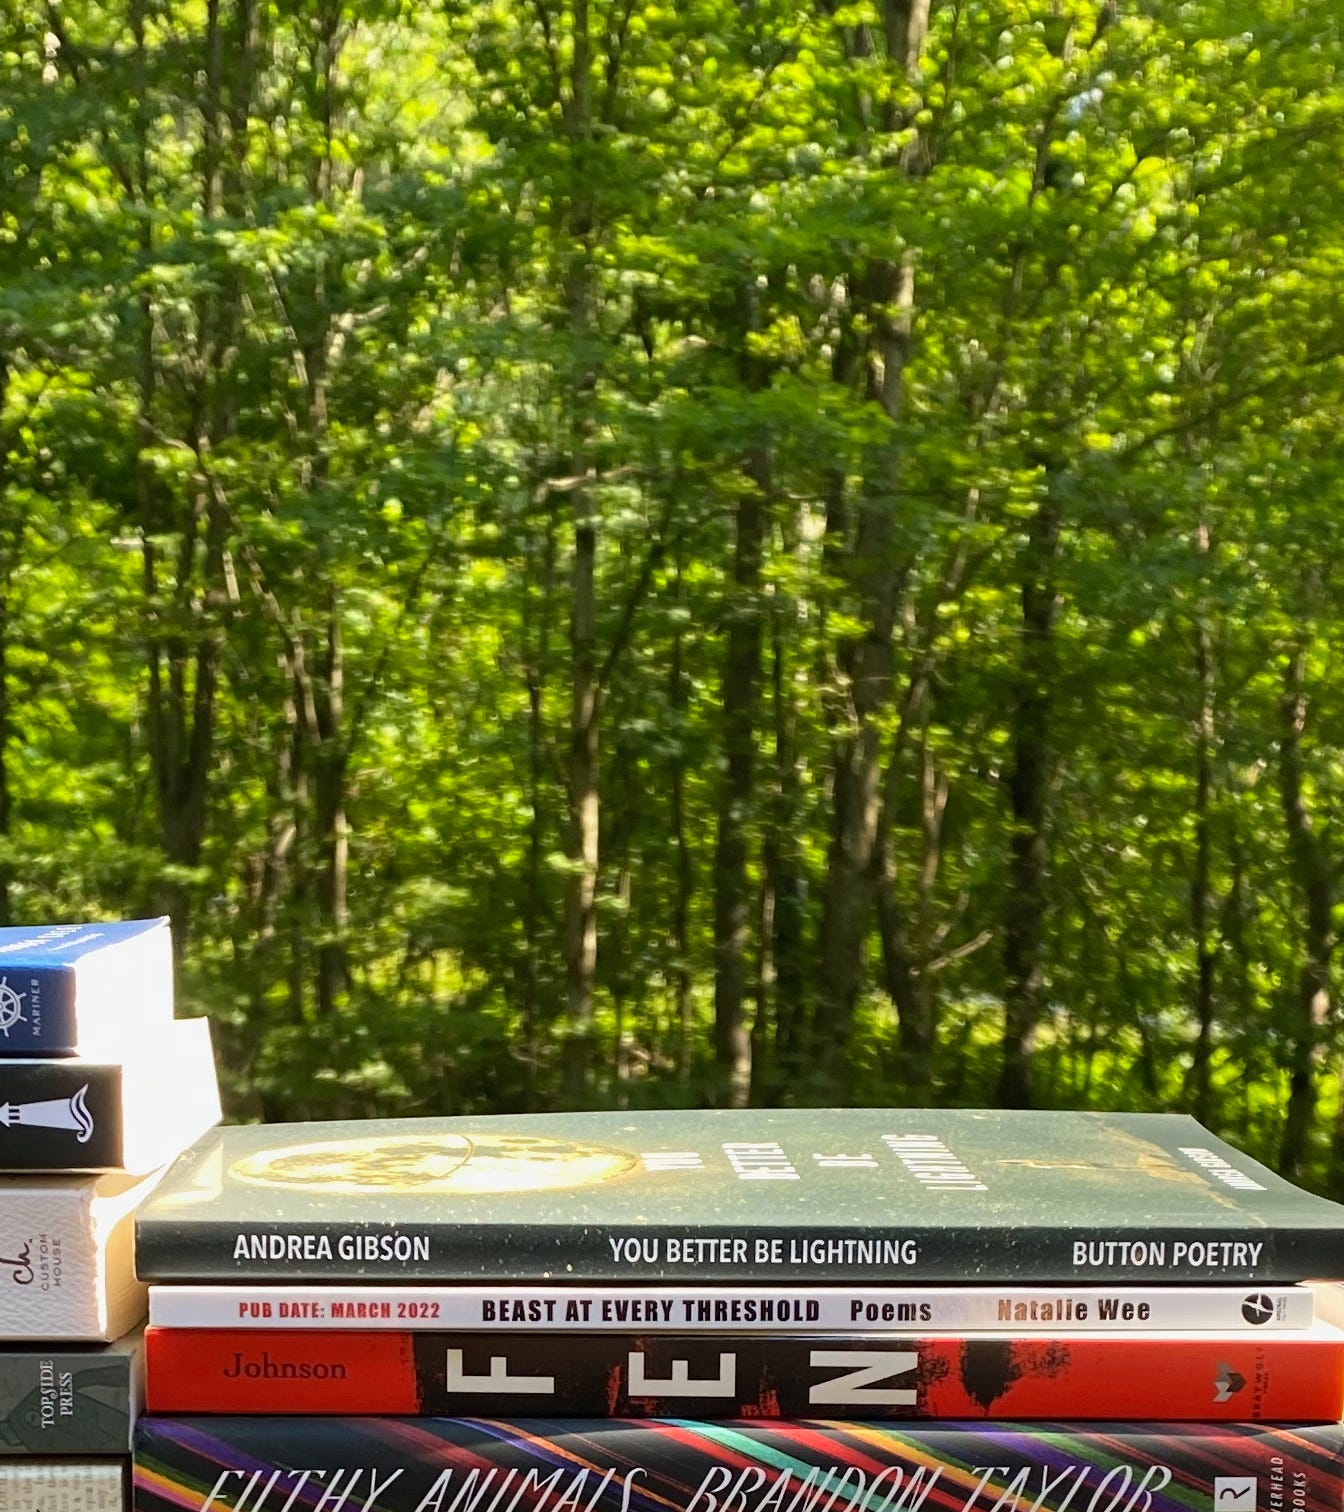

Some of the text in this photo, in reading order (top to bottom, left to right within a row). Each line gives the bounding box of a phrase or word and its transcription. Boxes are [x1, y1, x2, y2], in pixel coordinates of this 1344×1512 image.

[31, 979, 40, 1036] MARINER
[233, 1234, 430, 1262] ANDREA GIBSON
[610, 1237, 917, 1265] YOU BETTER BE LIGHTNING
[1072, 1241, 1263, 1267] BUTTON POETRY
[39, 1234, 49, 1291] CUSTOM
[52, 1239, 61, 1286] HOUSE
[238, 1302, 440, 1319] PUB DATE: MARCH 2022
[482, 1299, 820, 1322] BEAST AT EVERY THRESHOLD
[850, 1299, 932, 1322] Poems
[997, 1298, 1151, 1322] Natalie Wee
[223, 1352, 348, 1380] Johnson
[39, 1359, 55, 1428] TOPSIDE
[60, 1371, 74, 1416] PRESS
